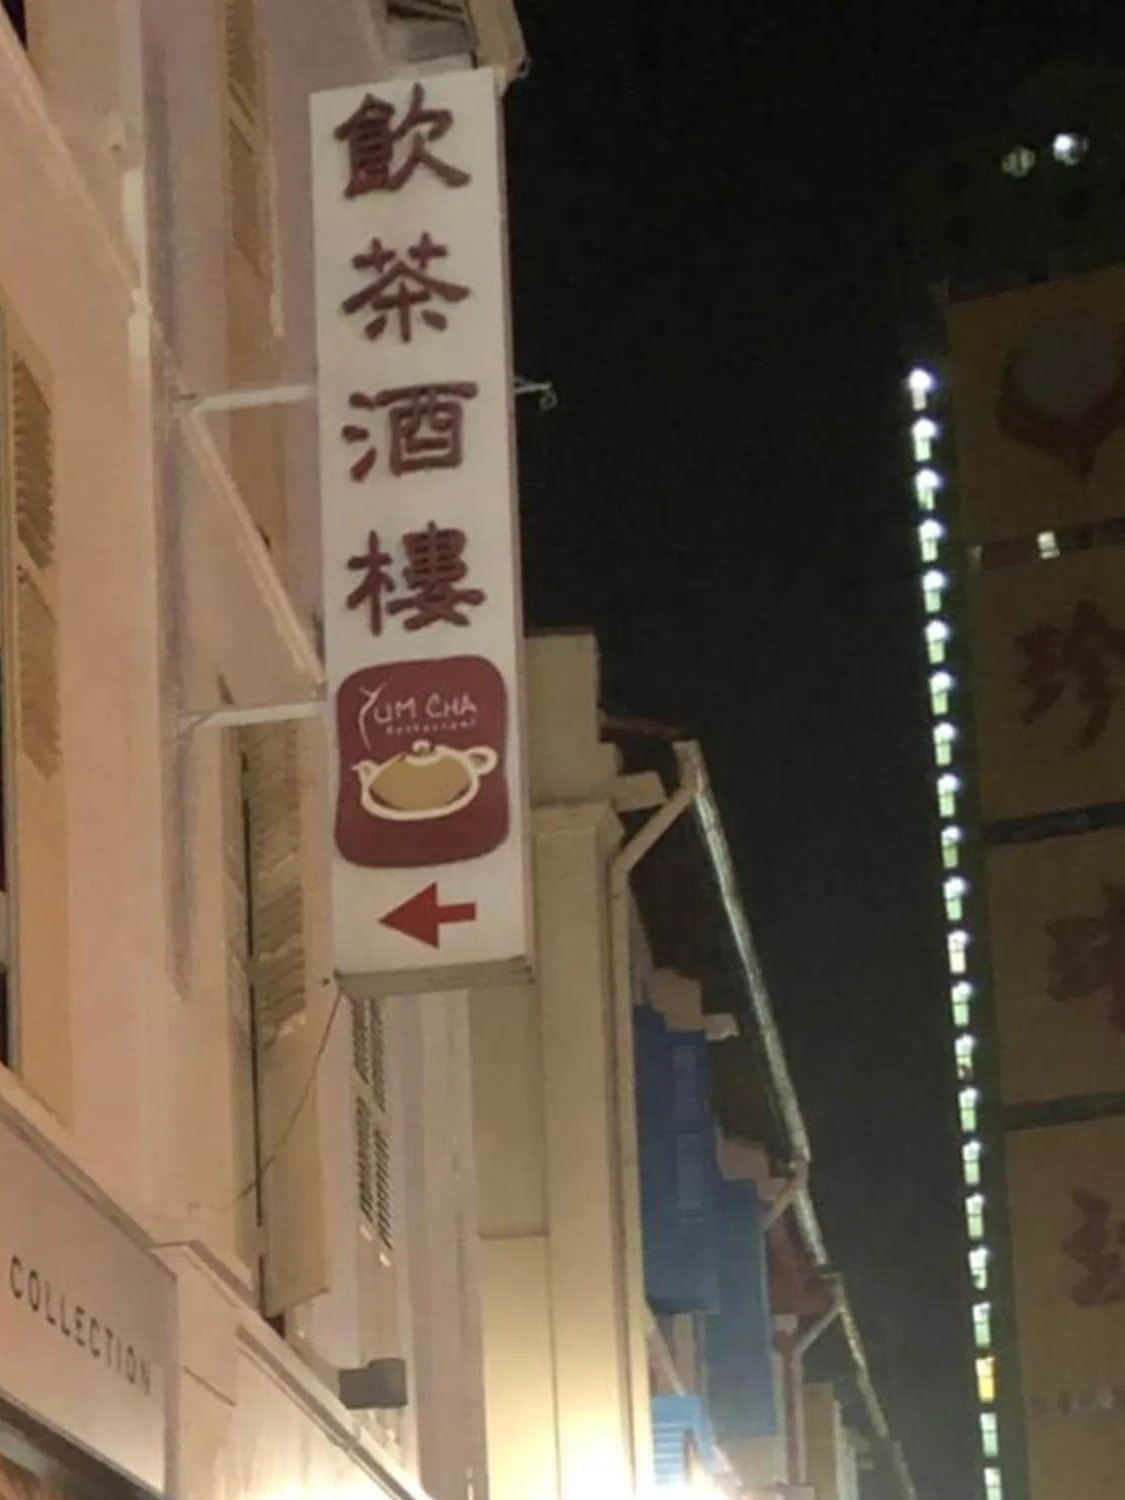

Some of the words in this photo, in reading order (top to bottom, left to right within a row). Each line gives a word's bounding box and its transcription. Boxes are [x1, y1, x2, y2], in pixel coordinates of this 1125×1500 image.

[333, 82, 485, 637] 飲茶酒樓
[358, 679, 417, 752] YUM
[426, 692, 479, 718] CHA
[9, 1254, 151, 1396] COLLECTION
